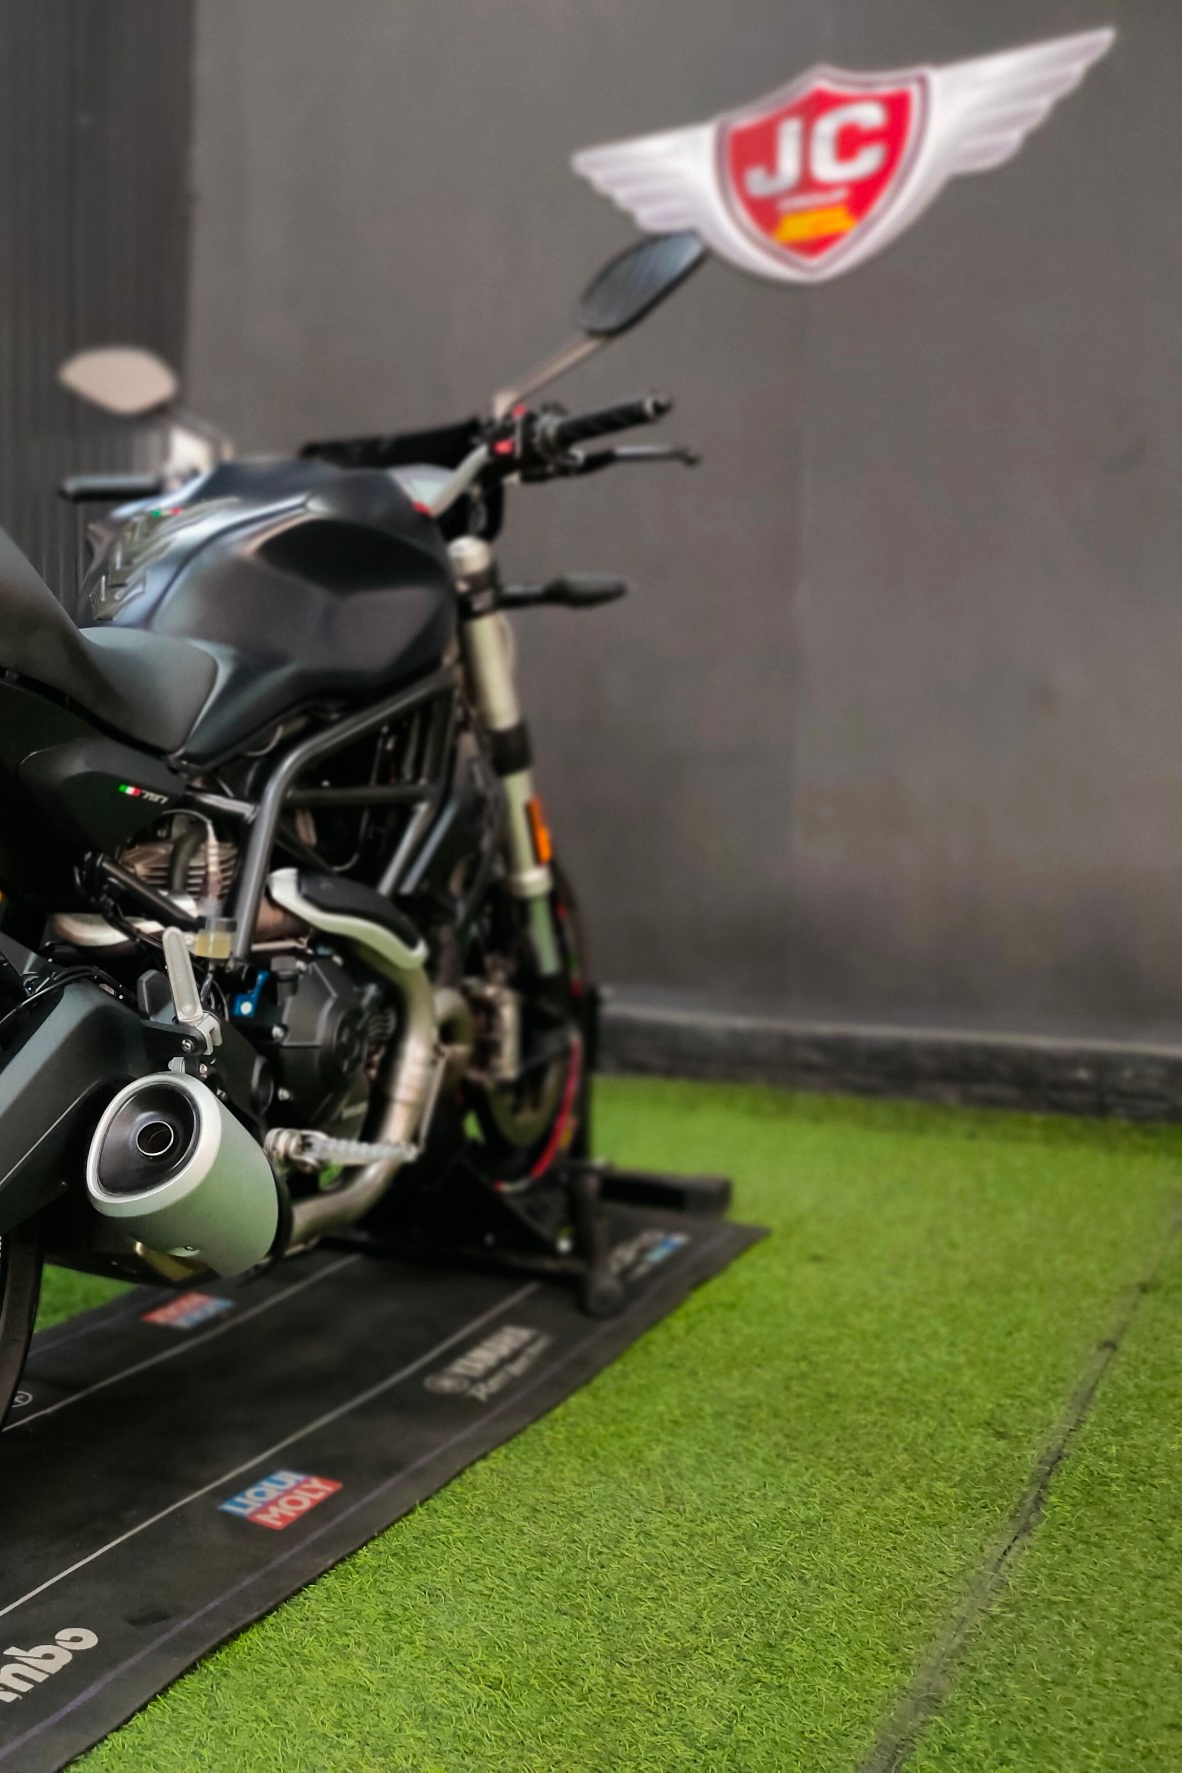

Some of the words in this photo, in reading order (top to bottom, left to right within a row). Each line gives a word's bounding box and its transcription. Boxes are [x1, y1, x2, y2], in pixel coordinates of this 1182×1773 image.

[744, 100, 886, 198] JC
[220, 1469, 309, 1518] LIQUI
[254, 1475, 336, 1527] MOLY
